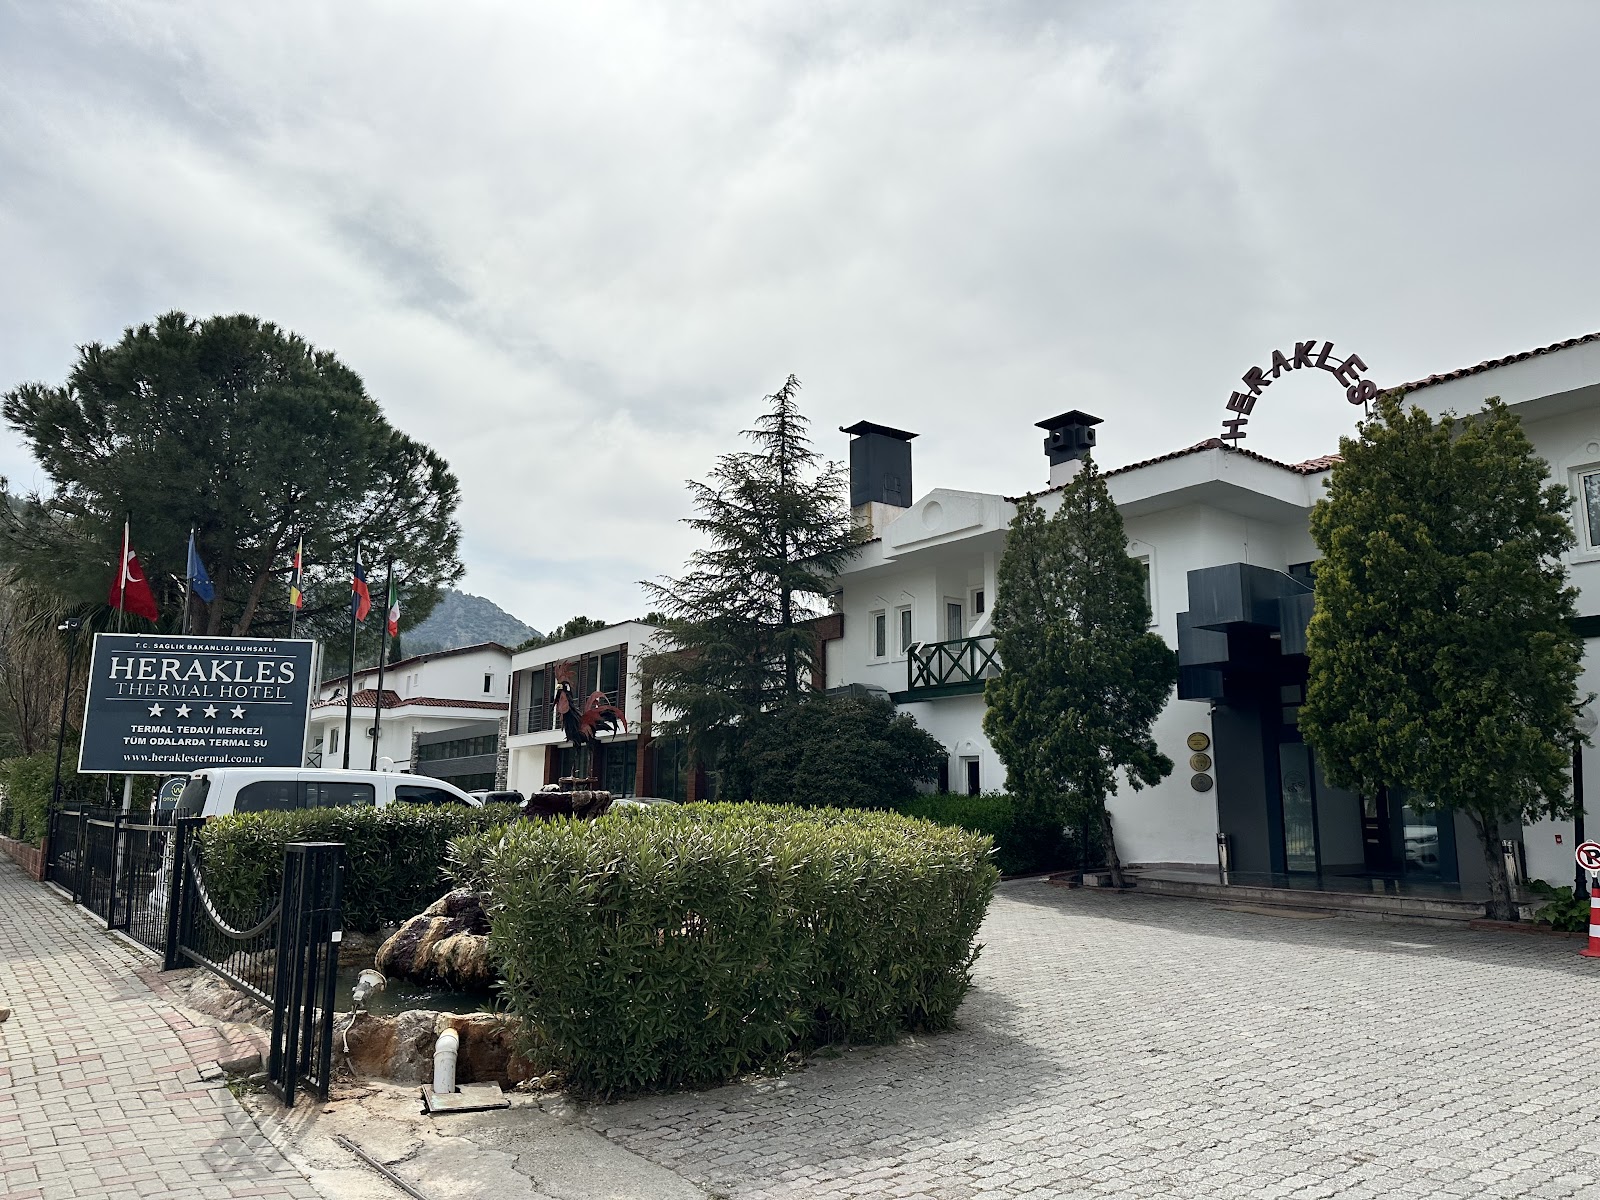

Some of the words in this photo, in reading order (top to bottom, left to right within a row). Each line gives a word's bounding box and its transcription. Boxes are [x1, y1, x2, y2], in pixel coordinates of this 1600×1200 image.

[1220, 340, 1377, 440] HERAKLES
[235, 645, 277, 653] RUHSATLI
[108, 656, 296, 684] HERAKLES
[115, 682, 214, 698] THERMAL
[219, 685, 286, 700] HOTEL
[130, 725, 174, 734] TERMAL
[176, 725, 214, 735] TEDAVİ
[216, 726, 263, 736] MERKEZİ
[123, 735, 147, 745] TÜM
[149, 737, 206, 747] ODALARDA
[208, 738, 251, 747] TERMAL
[253, 739, 268, 748] SU
[123, 752, 265, 764] www.heraklestermal.com.tr
